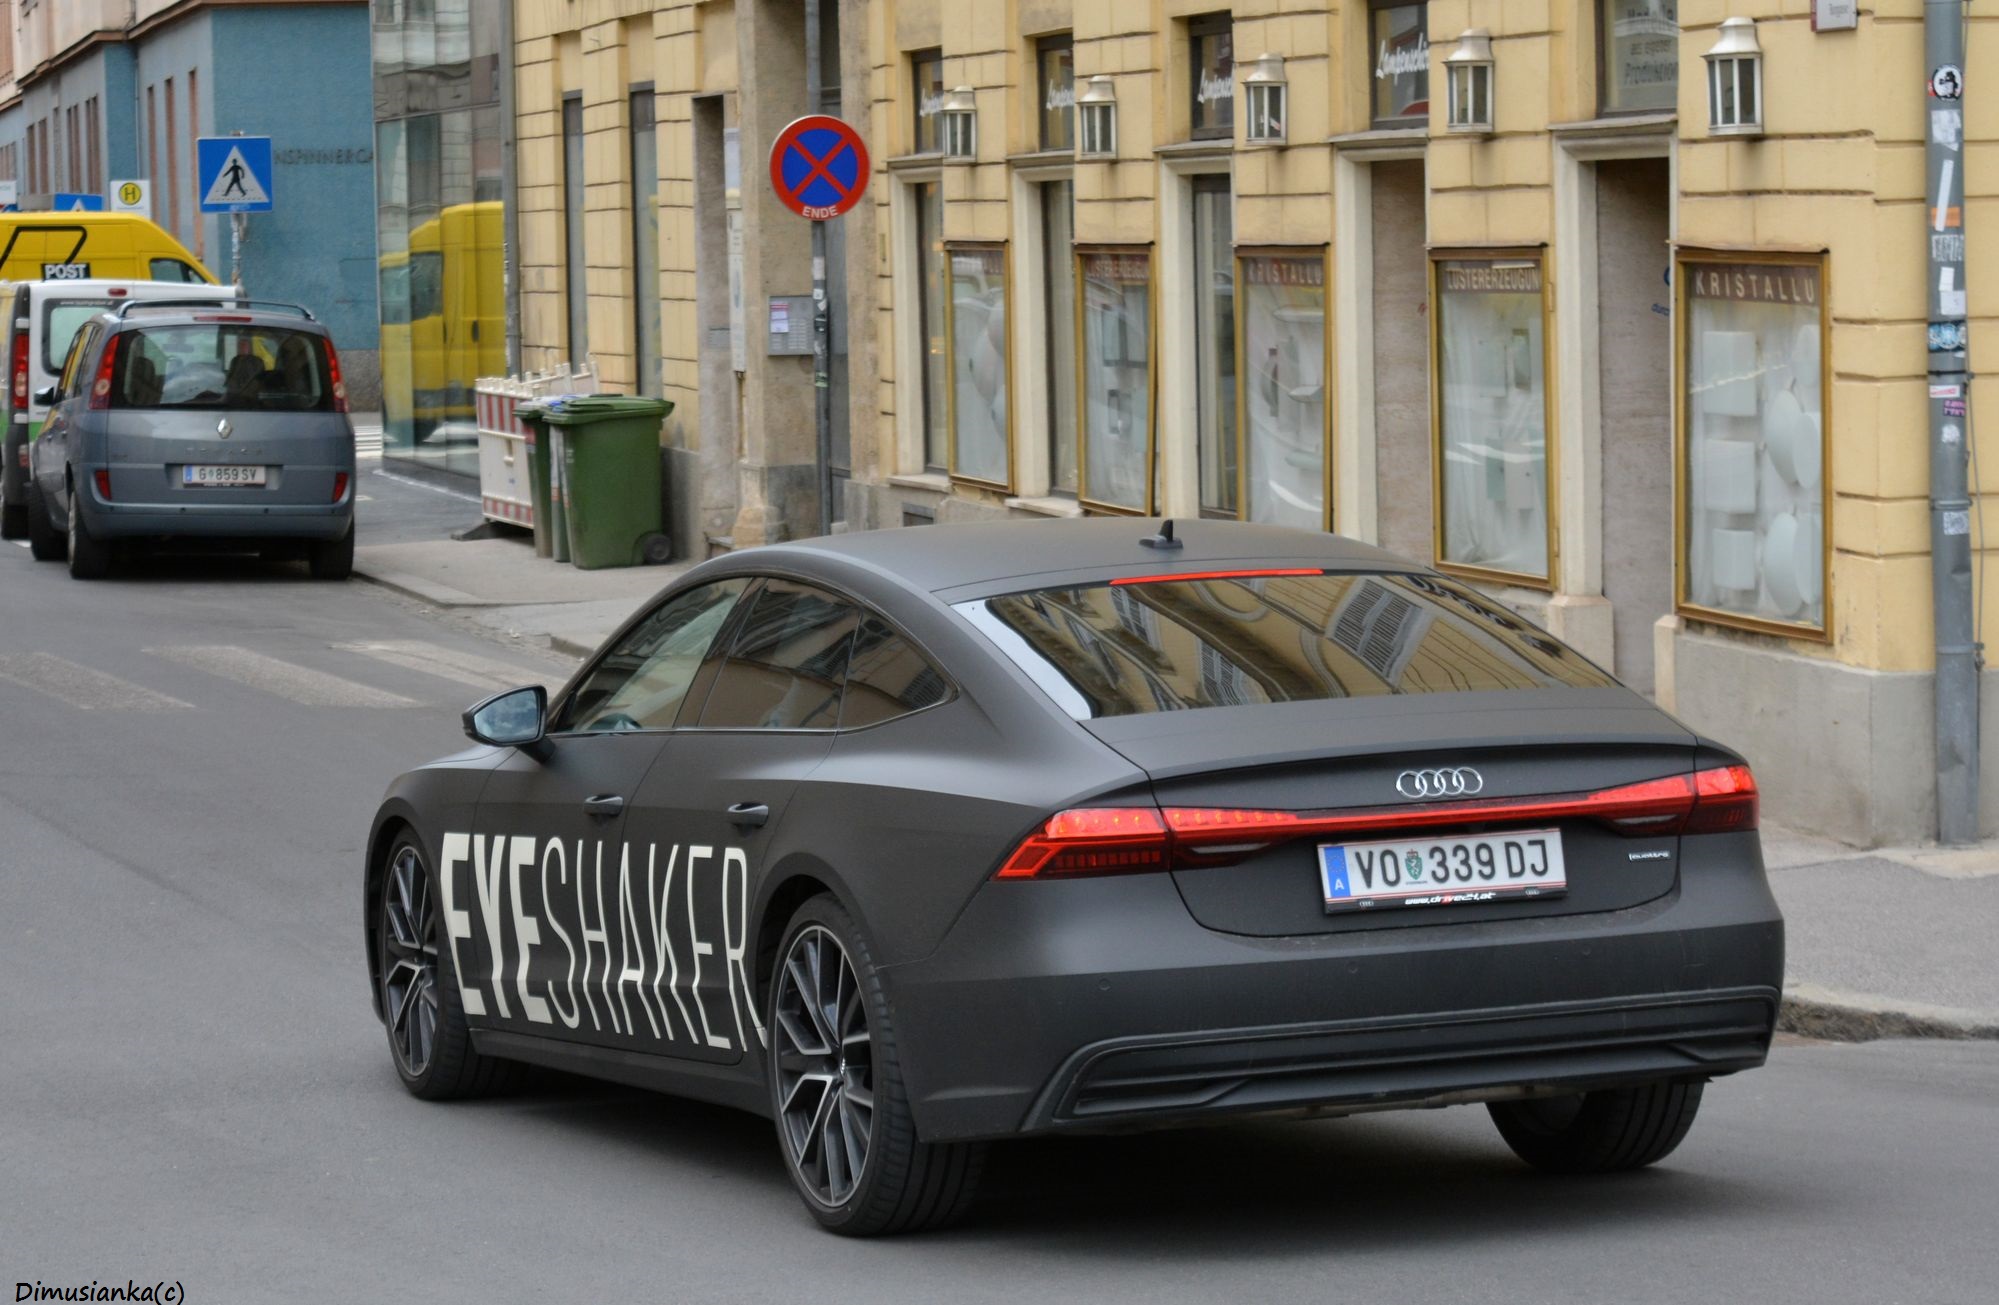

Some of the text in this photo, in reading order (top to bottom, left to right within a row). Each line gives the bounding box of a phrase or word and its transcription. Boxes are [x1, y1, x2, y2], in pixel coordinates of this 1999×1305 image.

[802, 205, 838, 218] ENDE
[44, 263, 87, 280] POST
[1695, 271, 1815, 303] KRISTALLU
[215, 467, 239, 480] 859
[1334, 839, 1549, 891] A VO 339 DJ
[440, 832, 768, 1052] EYESHAKER
